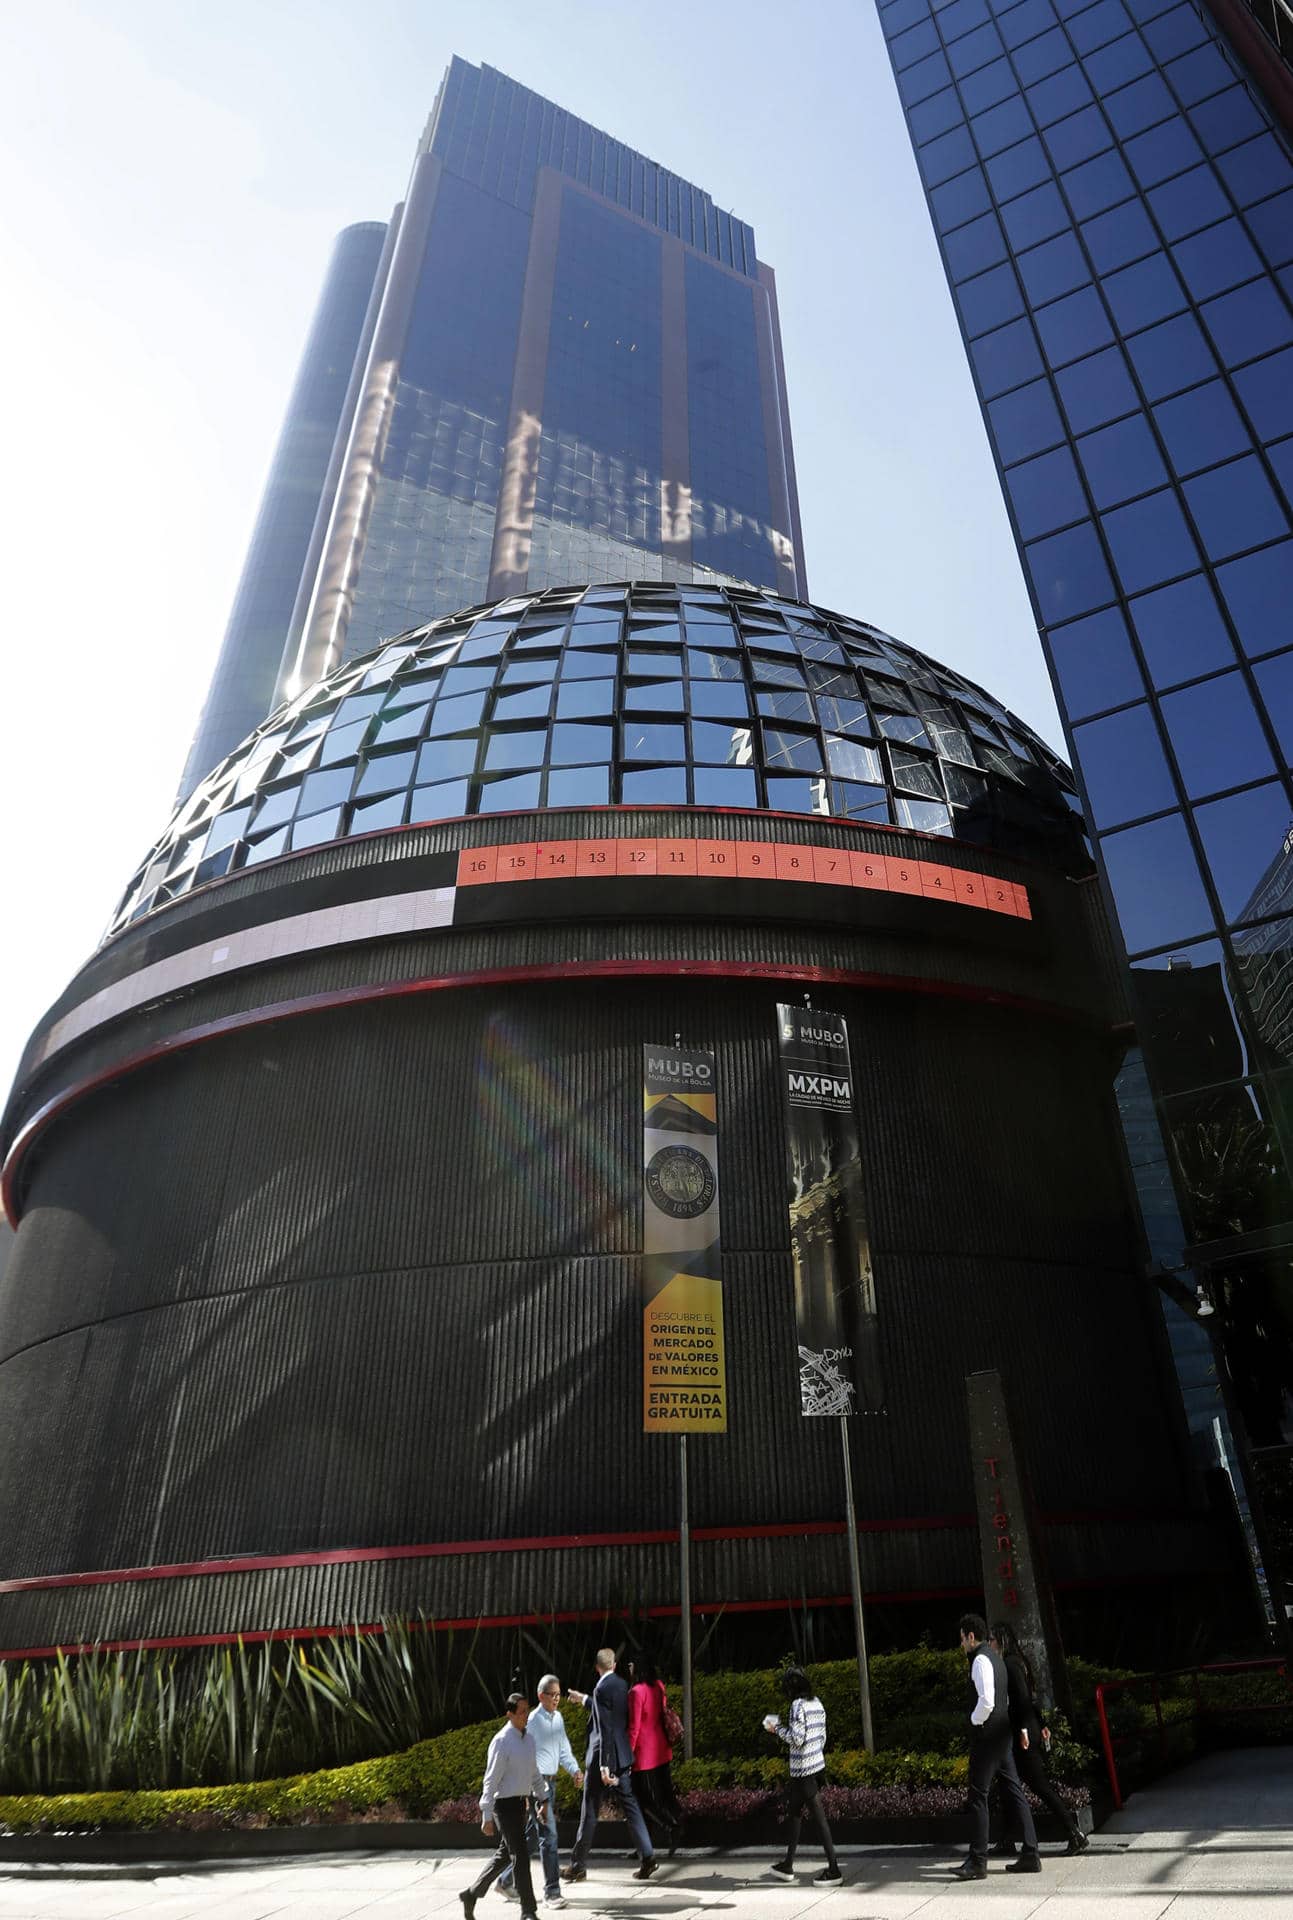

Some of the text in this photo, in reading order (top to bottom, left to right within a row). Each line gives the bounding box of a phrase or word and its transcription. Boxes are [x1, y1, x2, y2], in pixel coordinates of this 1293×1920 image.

[470, 851, 1005, 901] 16 15 14 13 12 11 10 9 8 7 6 5 4 3 2
[783, 1024, 794, 1038] 5
[800, 1025, 844, 1044] MUBO
[648, 1057, 711, 1079] MUBO
[788, 1073, 850, 1099] MXPM
[650, 1312, 715, 1322] DESCUBRE EL
[650, 1324, 717, 1336] ORIGEN DEL
[653, 1338, 714, 1349] MERCADO
[649, 1352, 719, 1363] DE VALORES
[652, 1364, 719, 1376] EN MÉXICO
[650, 1392, 722, 1405] ENTRADA
[648, 1407, 722, 1419] GRATUITA
